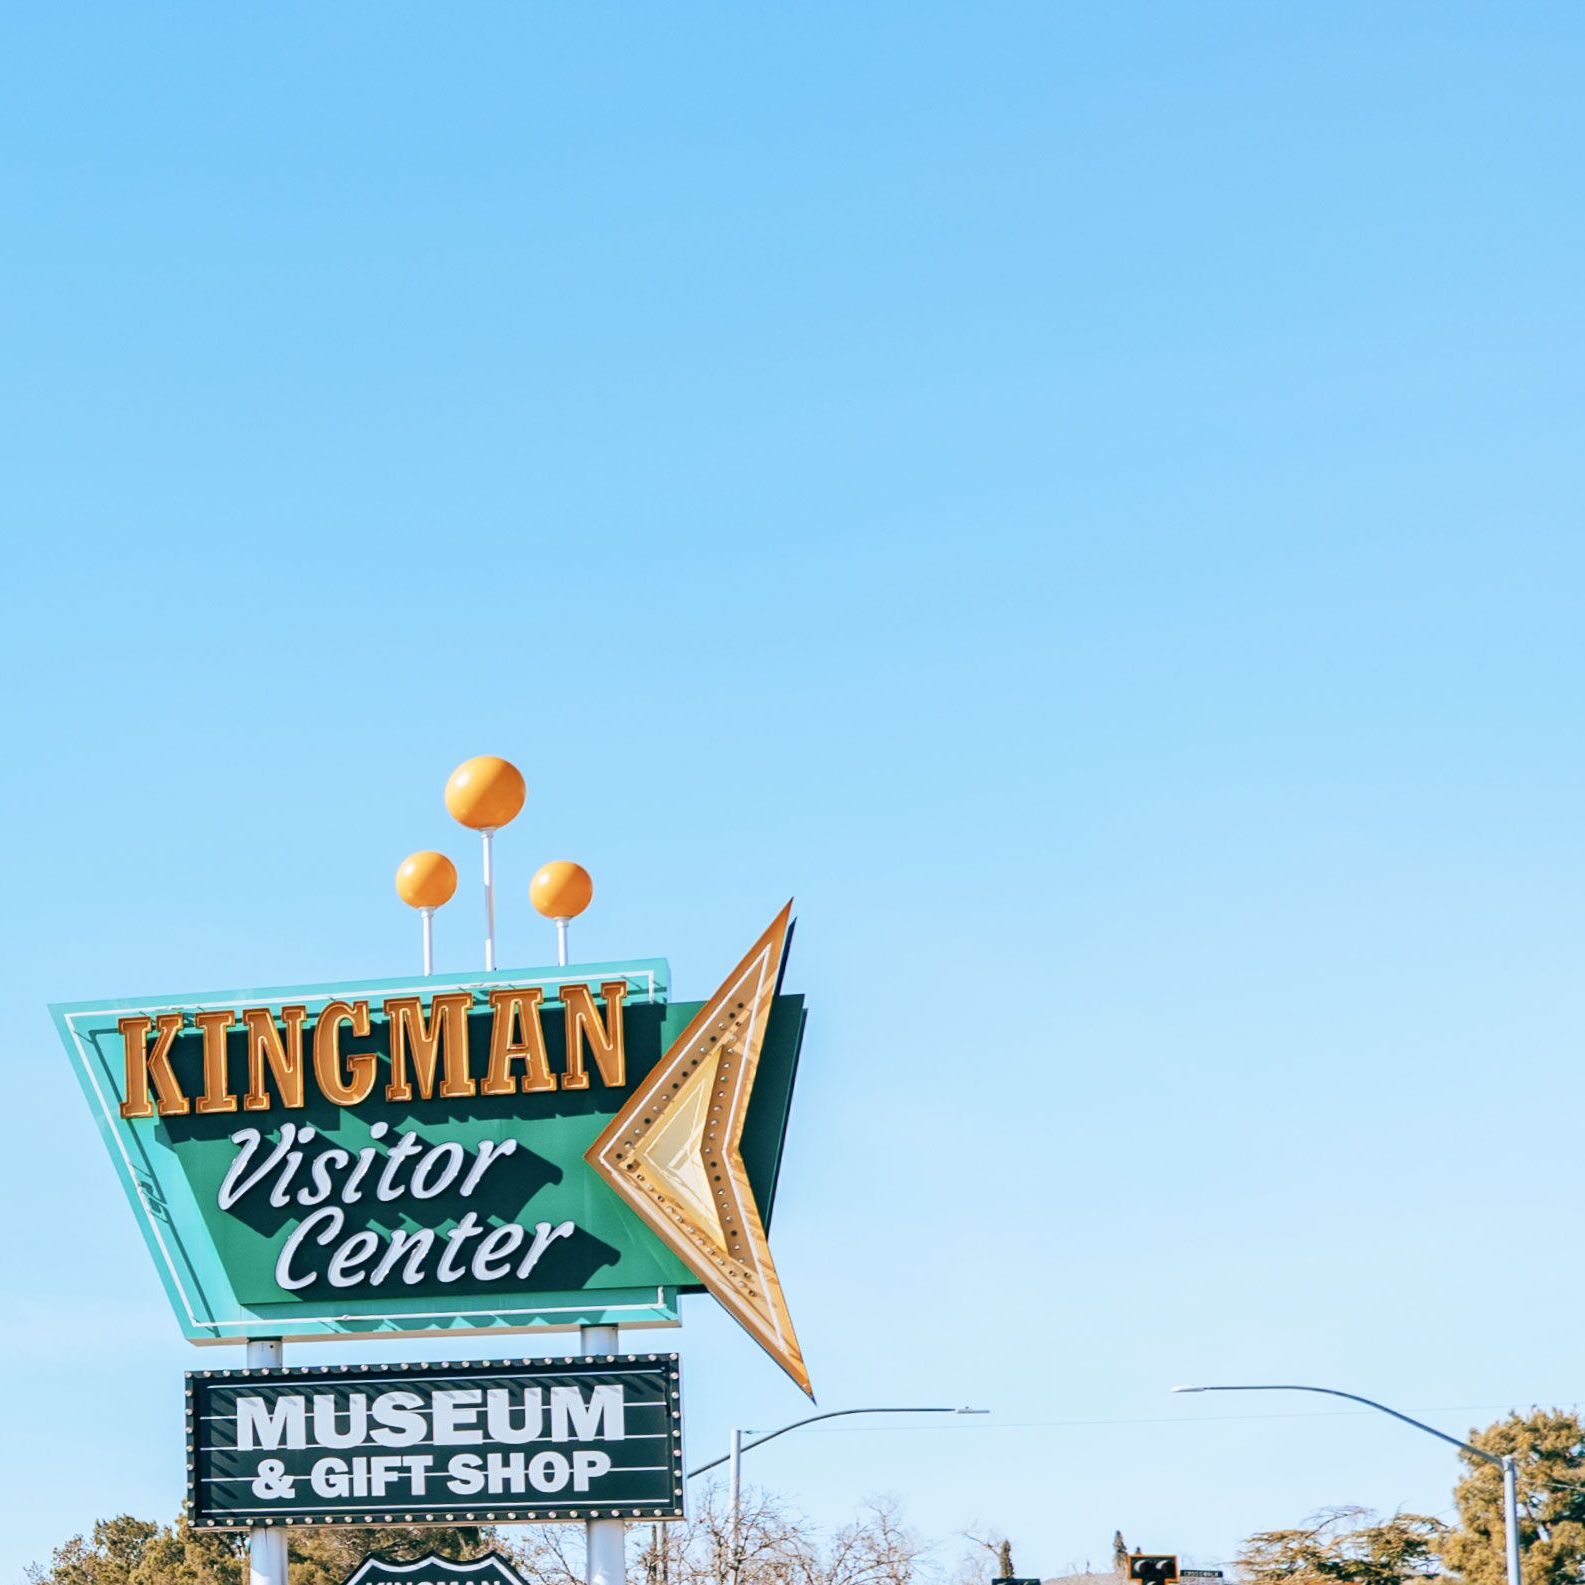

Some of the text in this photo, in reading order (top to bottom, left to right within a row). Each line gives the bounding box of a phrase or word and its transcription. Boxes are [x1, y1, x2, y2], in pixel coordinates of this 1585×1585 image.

[118, 980, 628, 1118] KINGMAN
[217, 1123, 517, 1212] Visitor
[275, 1207, 576, 1290] Center
[235, 1385, 625, 1451] MUSEUM
[251, 1450, 613, 1500] & GIFT SHOP
